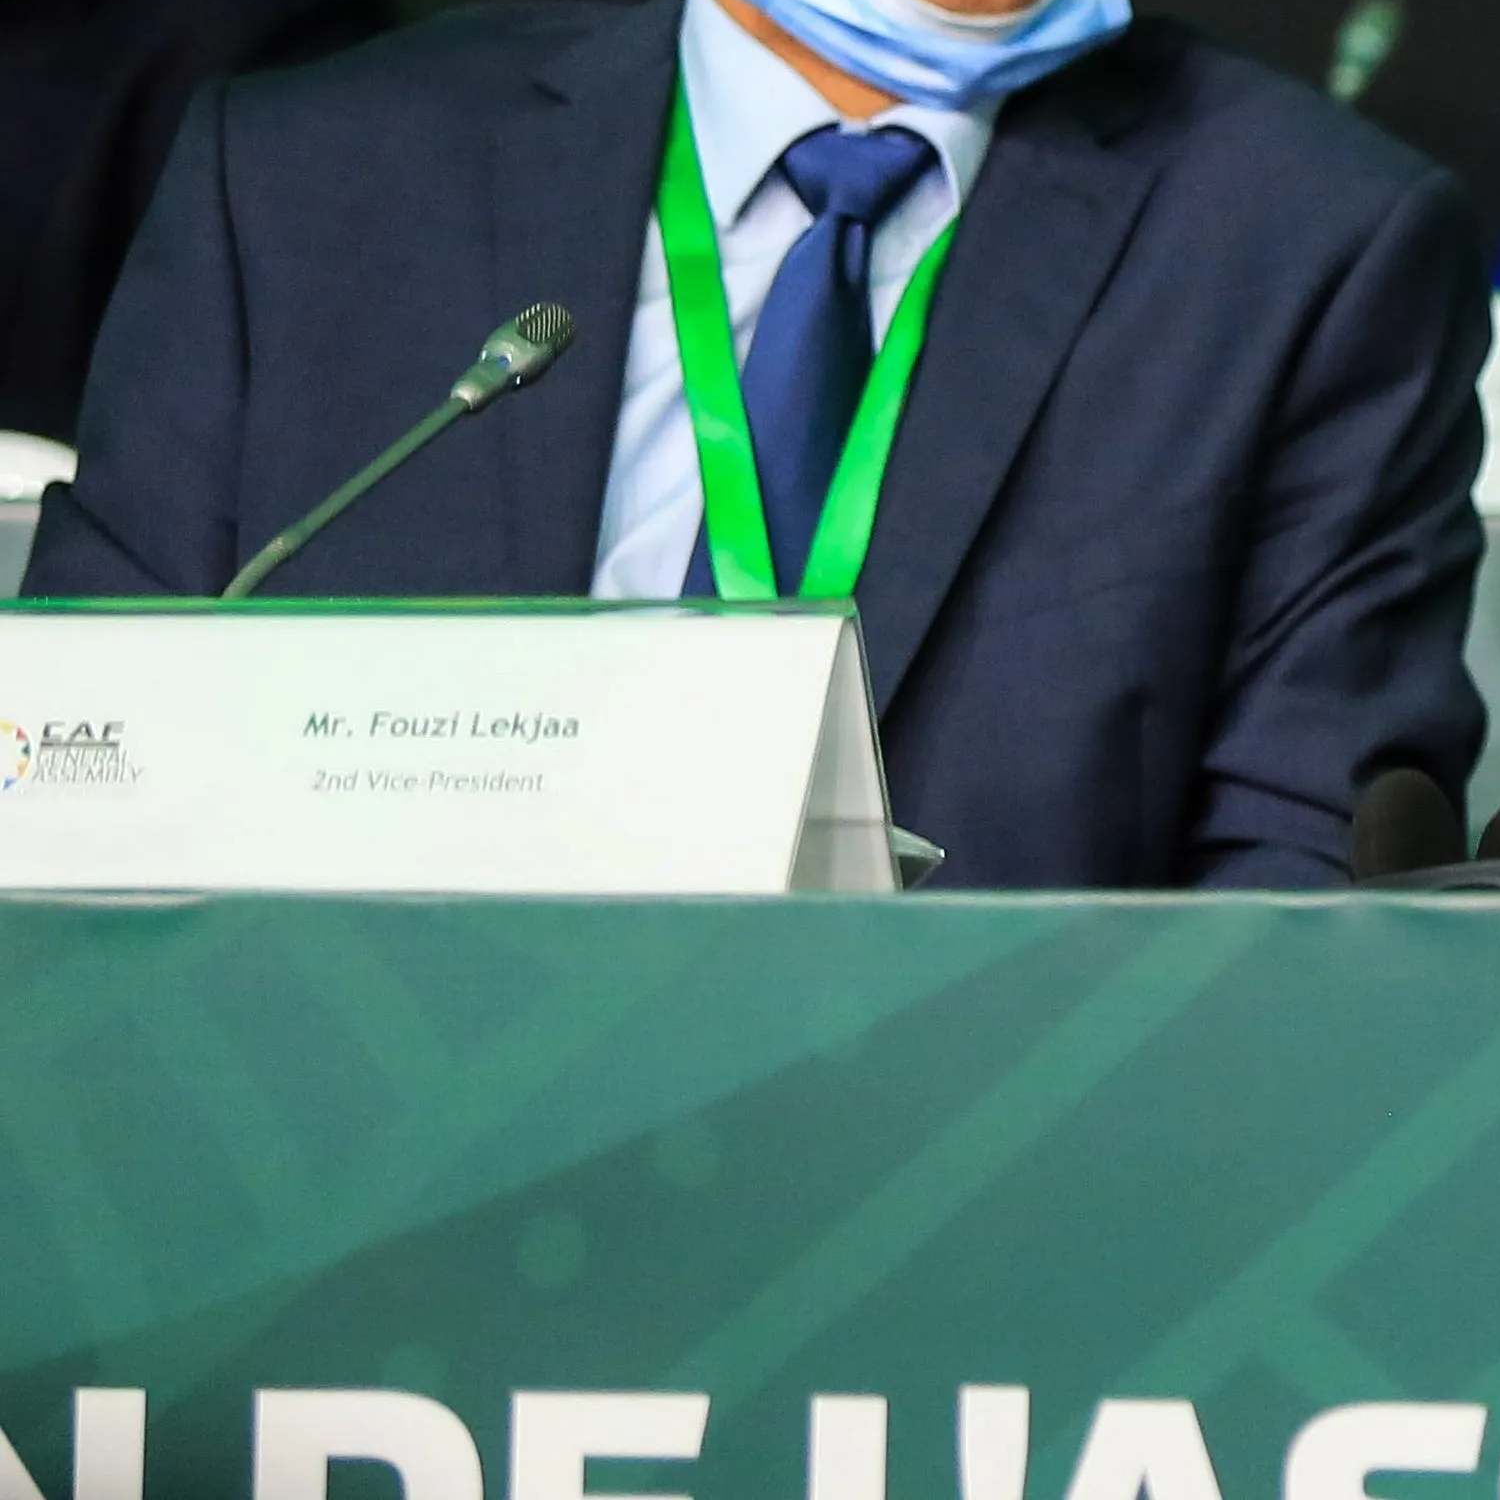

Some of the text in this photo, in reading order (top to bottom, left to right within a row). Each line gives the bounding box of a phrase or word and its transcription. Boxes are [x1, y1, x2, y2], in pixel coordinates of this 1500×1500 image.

[302, 710, 580, 744] Mr. Fouzi Lekjaa
[311, 768, 359, 792] 2nd
